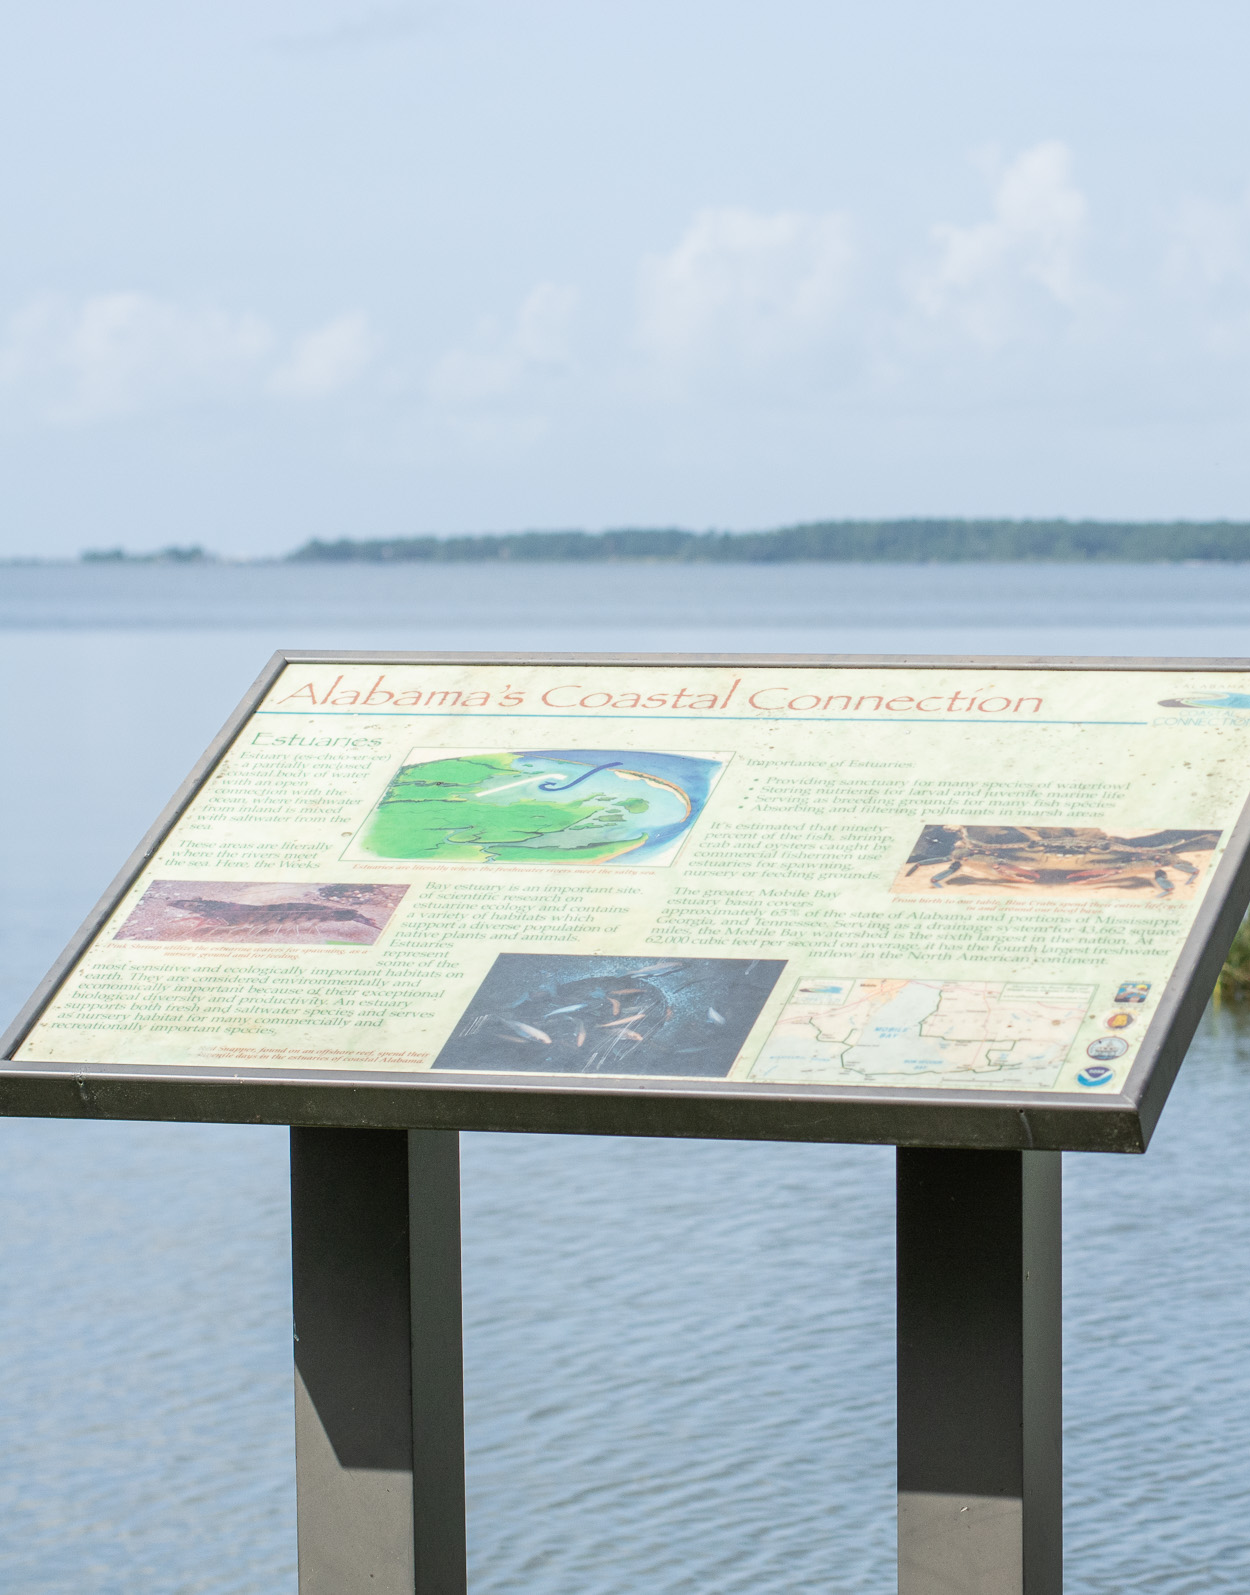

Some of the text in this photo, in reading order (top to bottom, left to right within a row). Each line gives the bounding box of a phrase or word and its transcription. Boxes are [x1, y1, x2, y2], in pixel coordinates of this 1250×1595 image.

[276, 675, 1043, 713] Alabama's Coastal Connection
[251, 731, 383, 748] Estuaries
[165, 857, 185, 867] the
[253, 858, 276, 868] the
[277, 858, 320, 868] Weeks
[172, 849, 318, 860] where the rivers meet
[420, 889, 435, 899] of
[435, 889, 499, 900] scientific
[502, 891, 563, 902] research
[426, 880, 451, 894] Bay
[452, 881, 505, 895] estuary
[507, 883, 520, 892] is
[521, 885, 540, 893] an
[542, 883, 614, 898] important
[675, 886, 841, 902] The greater Mobile Bay
[414, 899, 630, 915] estuarine ecology and contains
[667, 896, 720, 909] estuary
[723, 896, 763, 907] basin
[407, 909, 595, 923] a variety of habitats which
[661, 904, 766, 920] approximately
[769, 907, 802, 917] 65%
[803, 907, 820, 917] of
[822, 908, 846, 918] the
[848, 908, 884, 919] state
[886, 909, 903, 919] of
[905, 910, 973, 921] Alabama
[976, 911, 1006, 922] and
[1007, 912, 1072, 926] portions
[1074, 913, 1092, 924] of
[401, 918, 619, 936] support a diverse population of
[390, 937, 453, 949] Estuaries
[396, 928, 439, 939] native
[440, 929, 487, 943] plants
[488, 930, 519, 941] and
[383, 947, 449, 962] represent
[809, 948, 856, 959] inflow
[858, 950, 875, 959] in
[877, 950, 903, 960] the
[906, 950, 954, 961] North
[955, 951, 1030, 963] American
[92, 960, 464, 980] most sensitive and ecologically important habitats on
[376, 958, 459, 969] some of the
[129, 972, 162, 986] They
[165, 975, 189, 983] are
[190, 973, 269, 985] considered
[270, 975, 389, 991] environmentally
[391, 978, 421, 988] and
[79, 980, 444, 1002] economically important because of their exceptional
[72, 990, 140, 1004] biological
[141, 991, 204, 1006] diversity
[207, 993, 237, 1003] and
[332, 996, 355, 1006] An
[357, 997, 412, 1011] estuary
[65, 999, 435, 1019] supports both fresh and saltwater species and serves
[51, 1019, 146, 1034] recreationally
[148, 1021, 222, 1036] important
[75, 1012, 130, 1024] nursery
[132, 1011, 184, 1022] habitat
[184, 1013, 207, 1023] for
[209, 1016, 251, 1027] many
[252, 1015, 350, 1030] commercially
[352, 1017, 383, 1028] and
